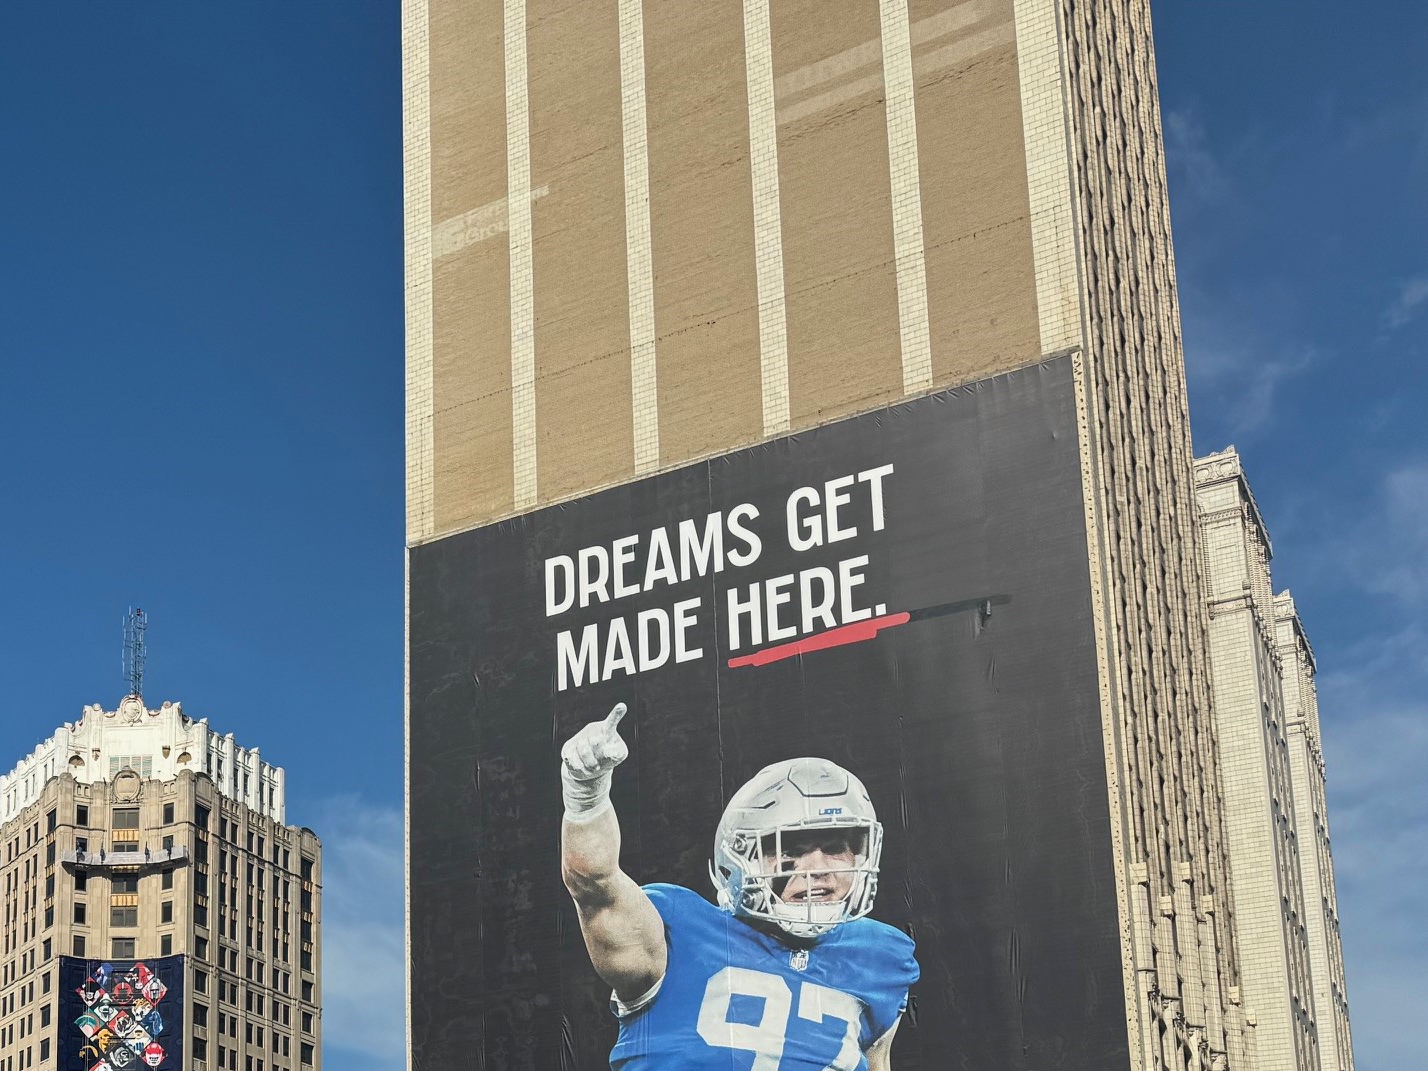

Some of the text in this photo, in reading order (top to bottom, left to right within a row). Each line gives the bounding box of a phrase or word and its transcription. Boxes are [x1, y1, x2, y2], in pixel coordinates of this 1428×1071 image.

[544, 463, 894, 617] DREAMS GET
[557, 554, 887, 691] MADE HERE.
